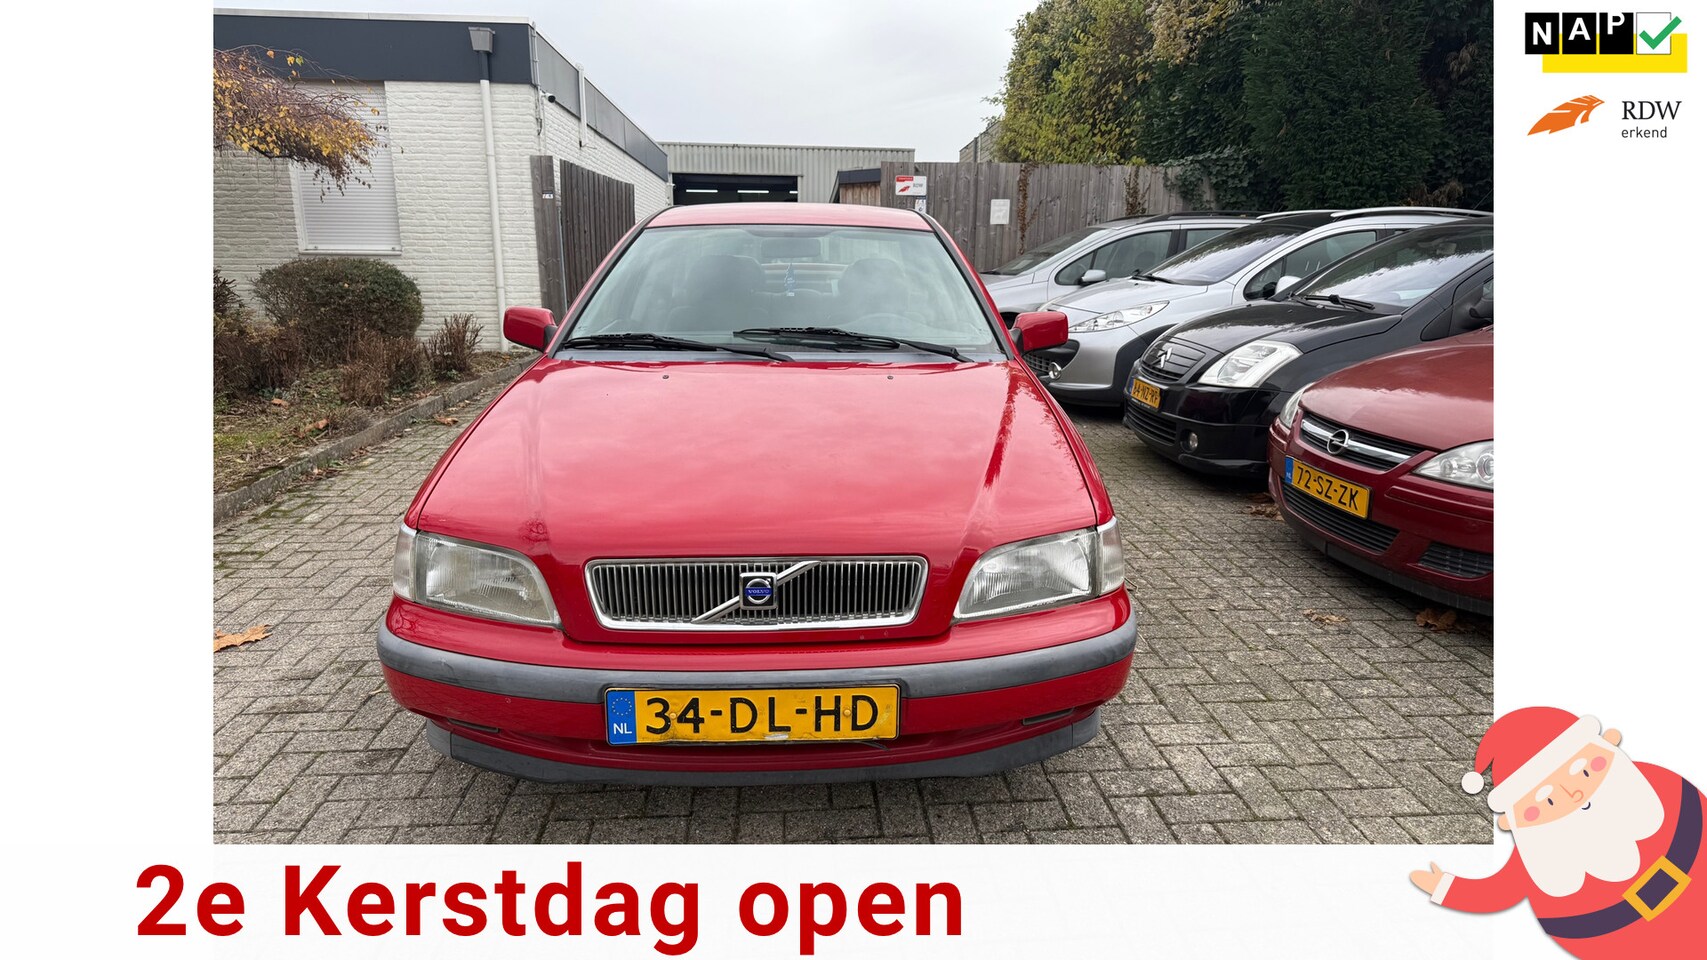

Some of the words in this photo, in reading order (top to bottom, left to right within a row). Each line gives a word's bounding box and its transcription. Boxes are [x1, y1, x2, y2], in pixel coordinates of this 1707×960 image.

[1297, 466, 1358, 510] 72-SZ-ZK
[613, 723, 632, 734] NL
[646, 695, 878, 734] 34-DL-HD
